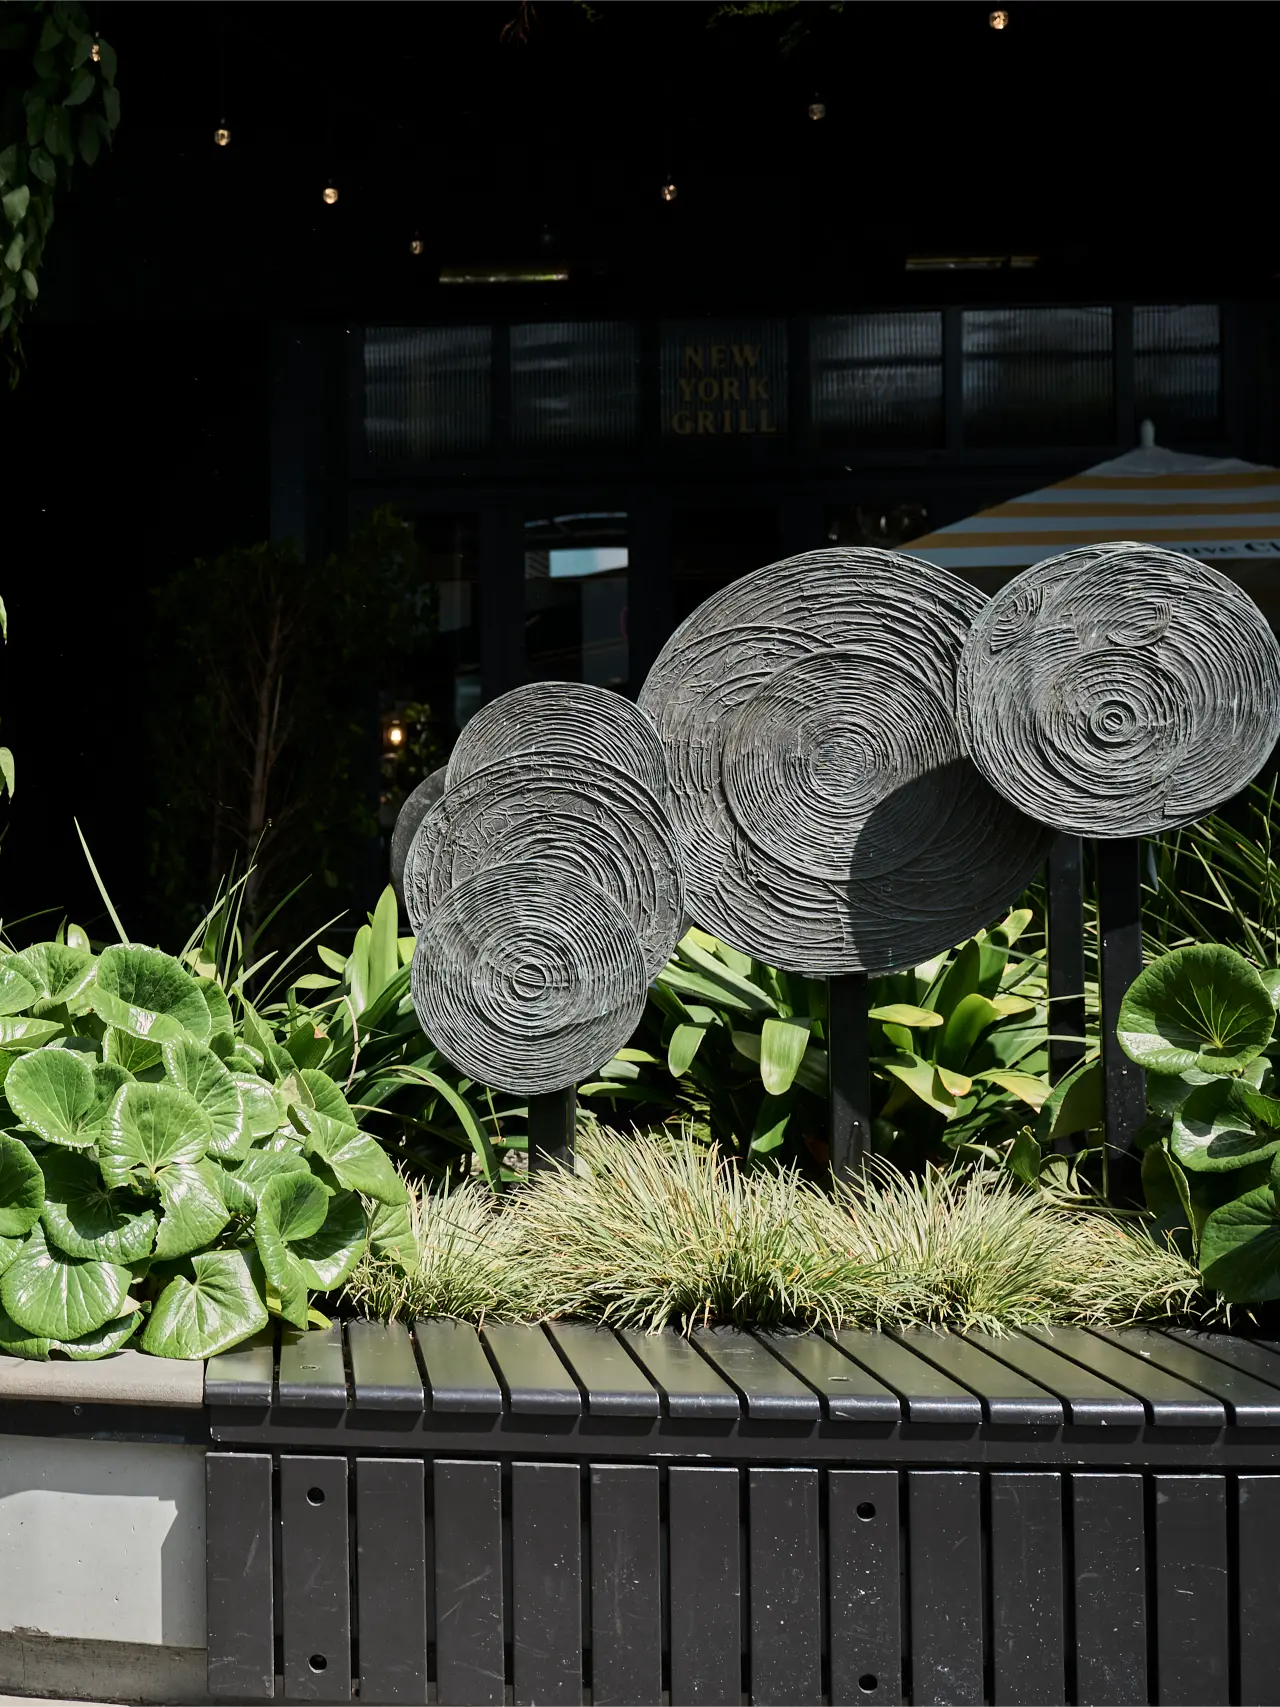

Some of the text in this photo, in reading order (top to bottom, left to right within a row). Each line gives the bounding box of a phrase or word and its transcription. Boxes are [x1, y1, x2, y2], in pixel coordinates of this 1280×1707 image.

[683, 344, 762, 370] NEW
[677, 377, 769, 402] YORK
[671, 409, 778, 435] GRILL
